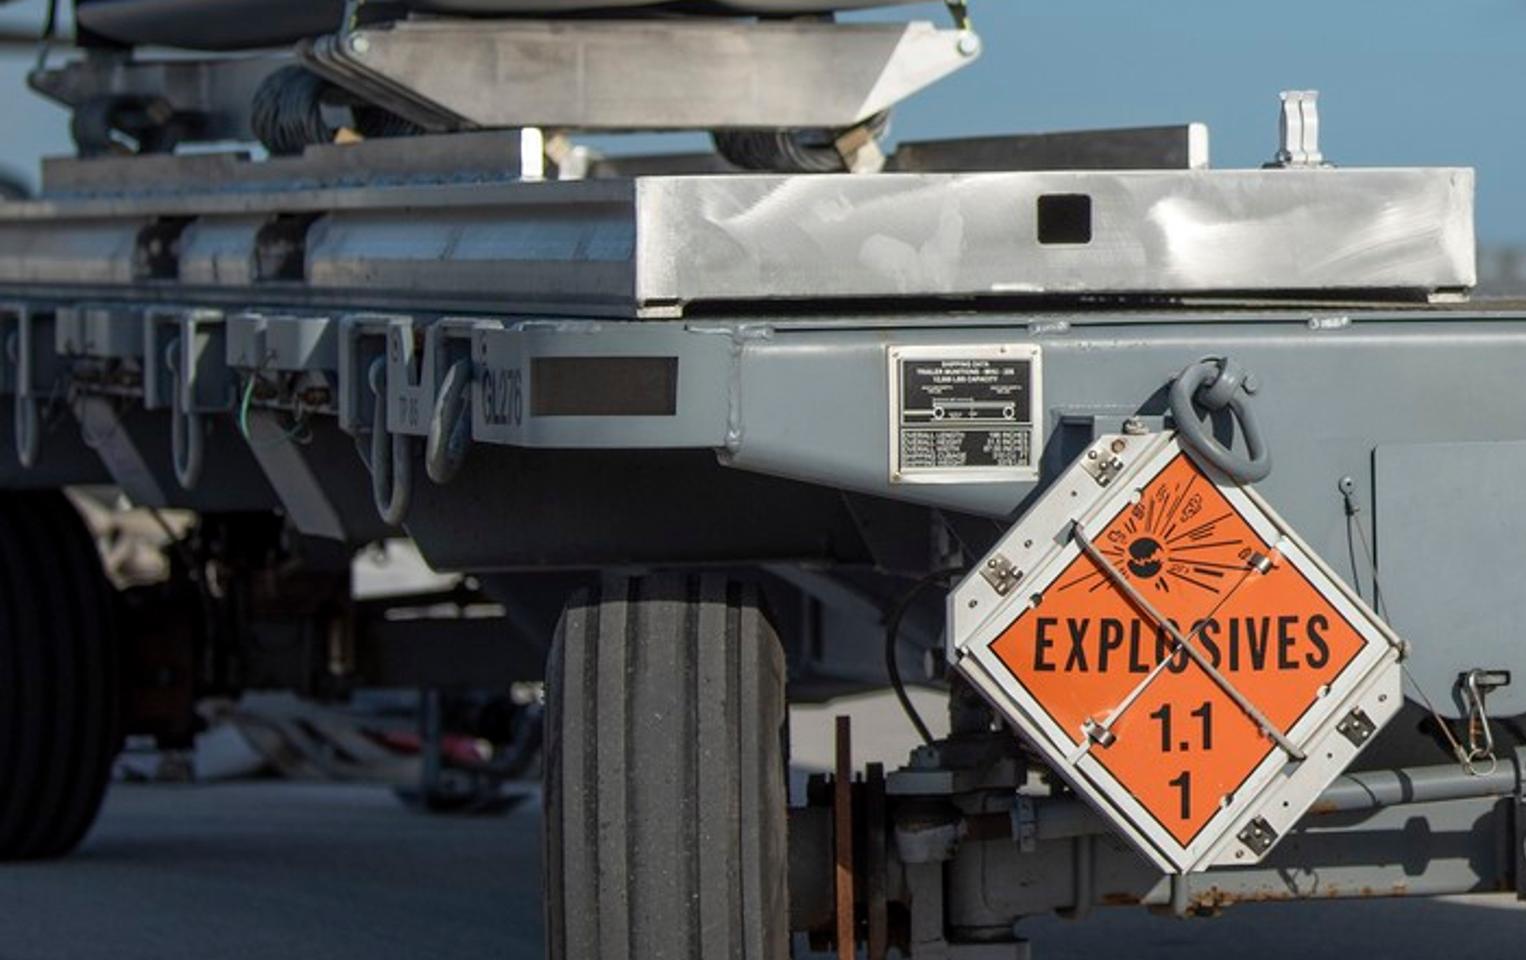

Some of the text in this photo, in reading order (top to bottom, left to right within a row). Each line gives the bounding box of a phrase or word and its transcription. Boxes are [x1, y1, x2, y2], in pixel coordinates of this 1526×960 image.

[1032, 612, 1332, 674] EXPLOSIVES
[1149, 700, 1214, 753] 1.1
[1168, 769, 1192, 821] 1
